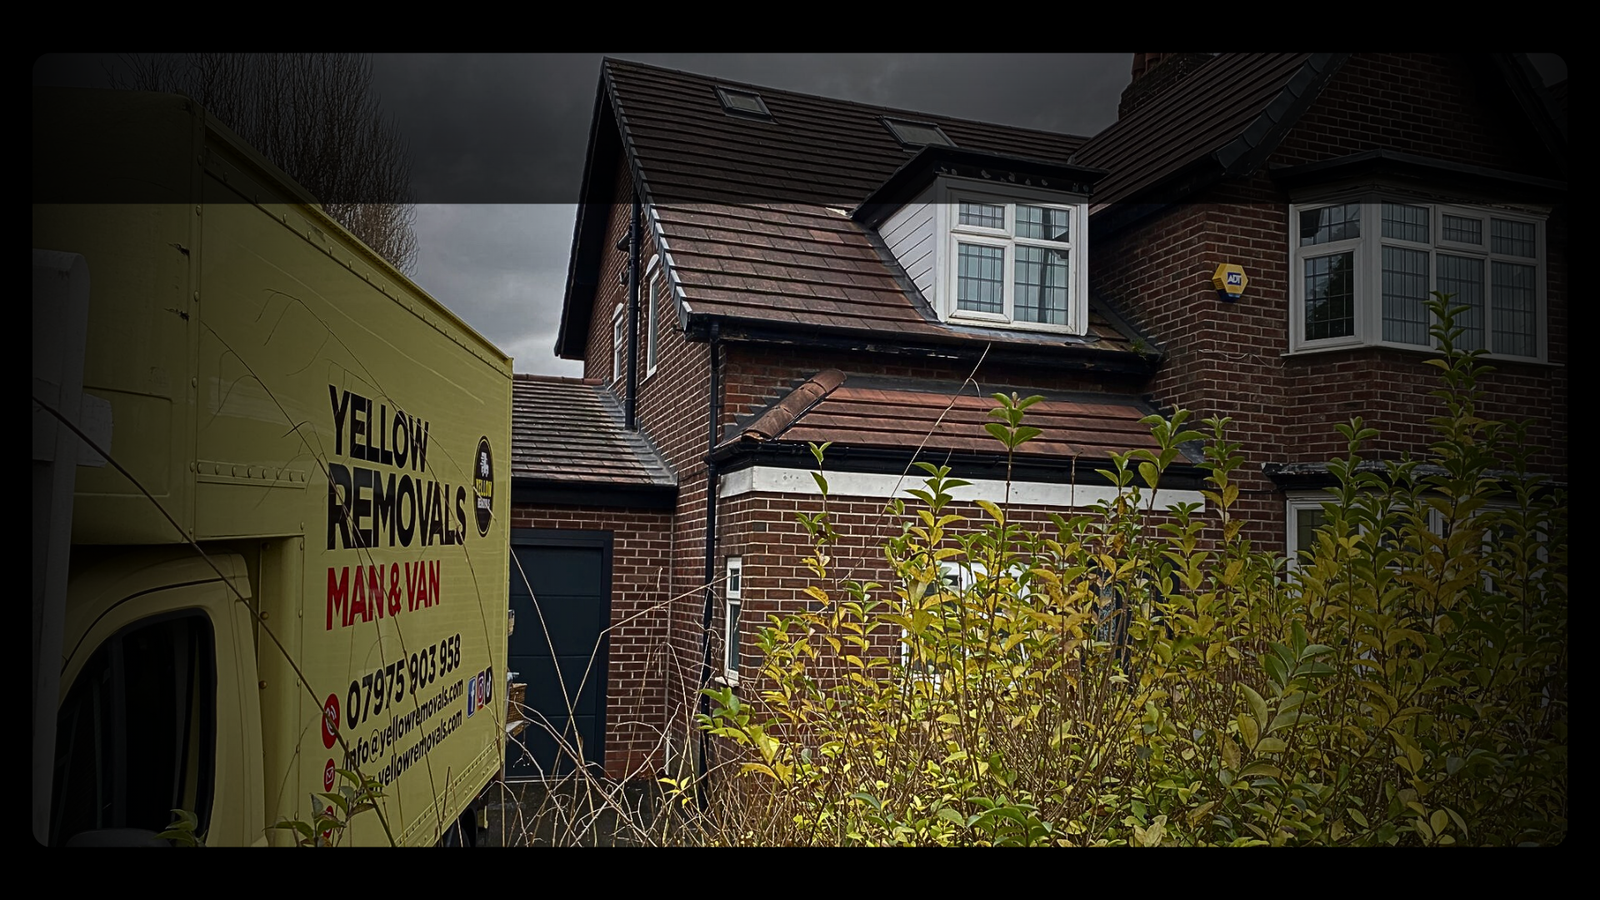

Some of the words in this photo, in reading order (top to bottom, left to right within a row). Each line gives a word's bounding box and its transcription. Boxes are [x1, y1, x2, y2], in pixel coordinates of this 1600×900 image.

[1227, 274, 1242, 284] ADT
[328, 384, 429, 472] YELLOW
[327, 462, 466, 550] REMOVALS
[326, 564, 385, 630] MAN
[388, 562, 402, 617] &
[405, 560, 441, 612] VAN
[346, 659, 405, 730] 07975
[410, 644, 436, 695] 903
[439, 633, 461, 678] 958
